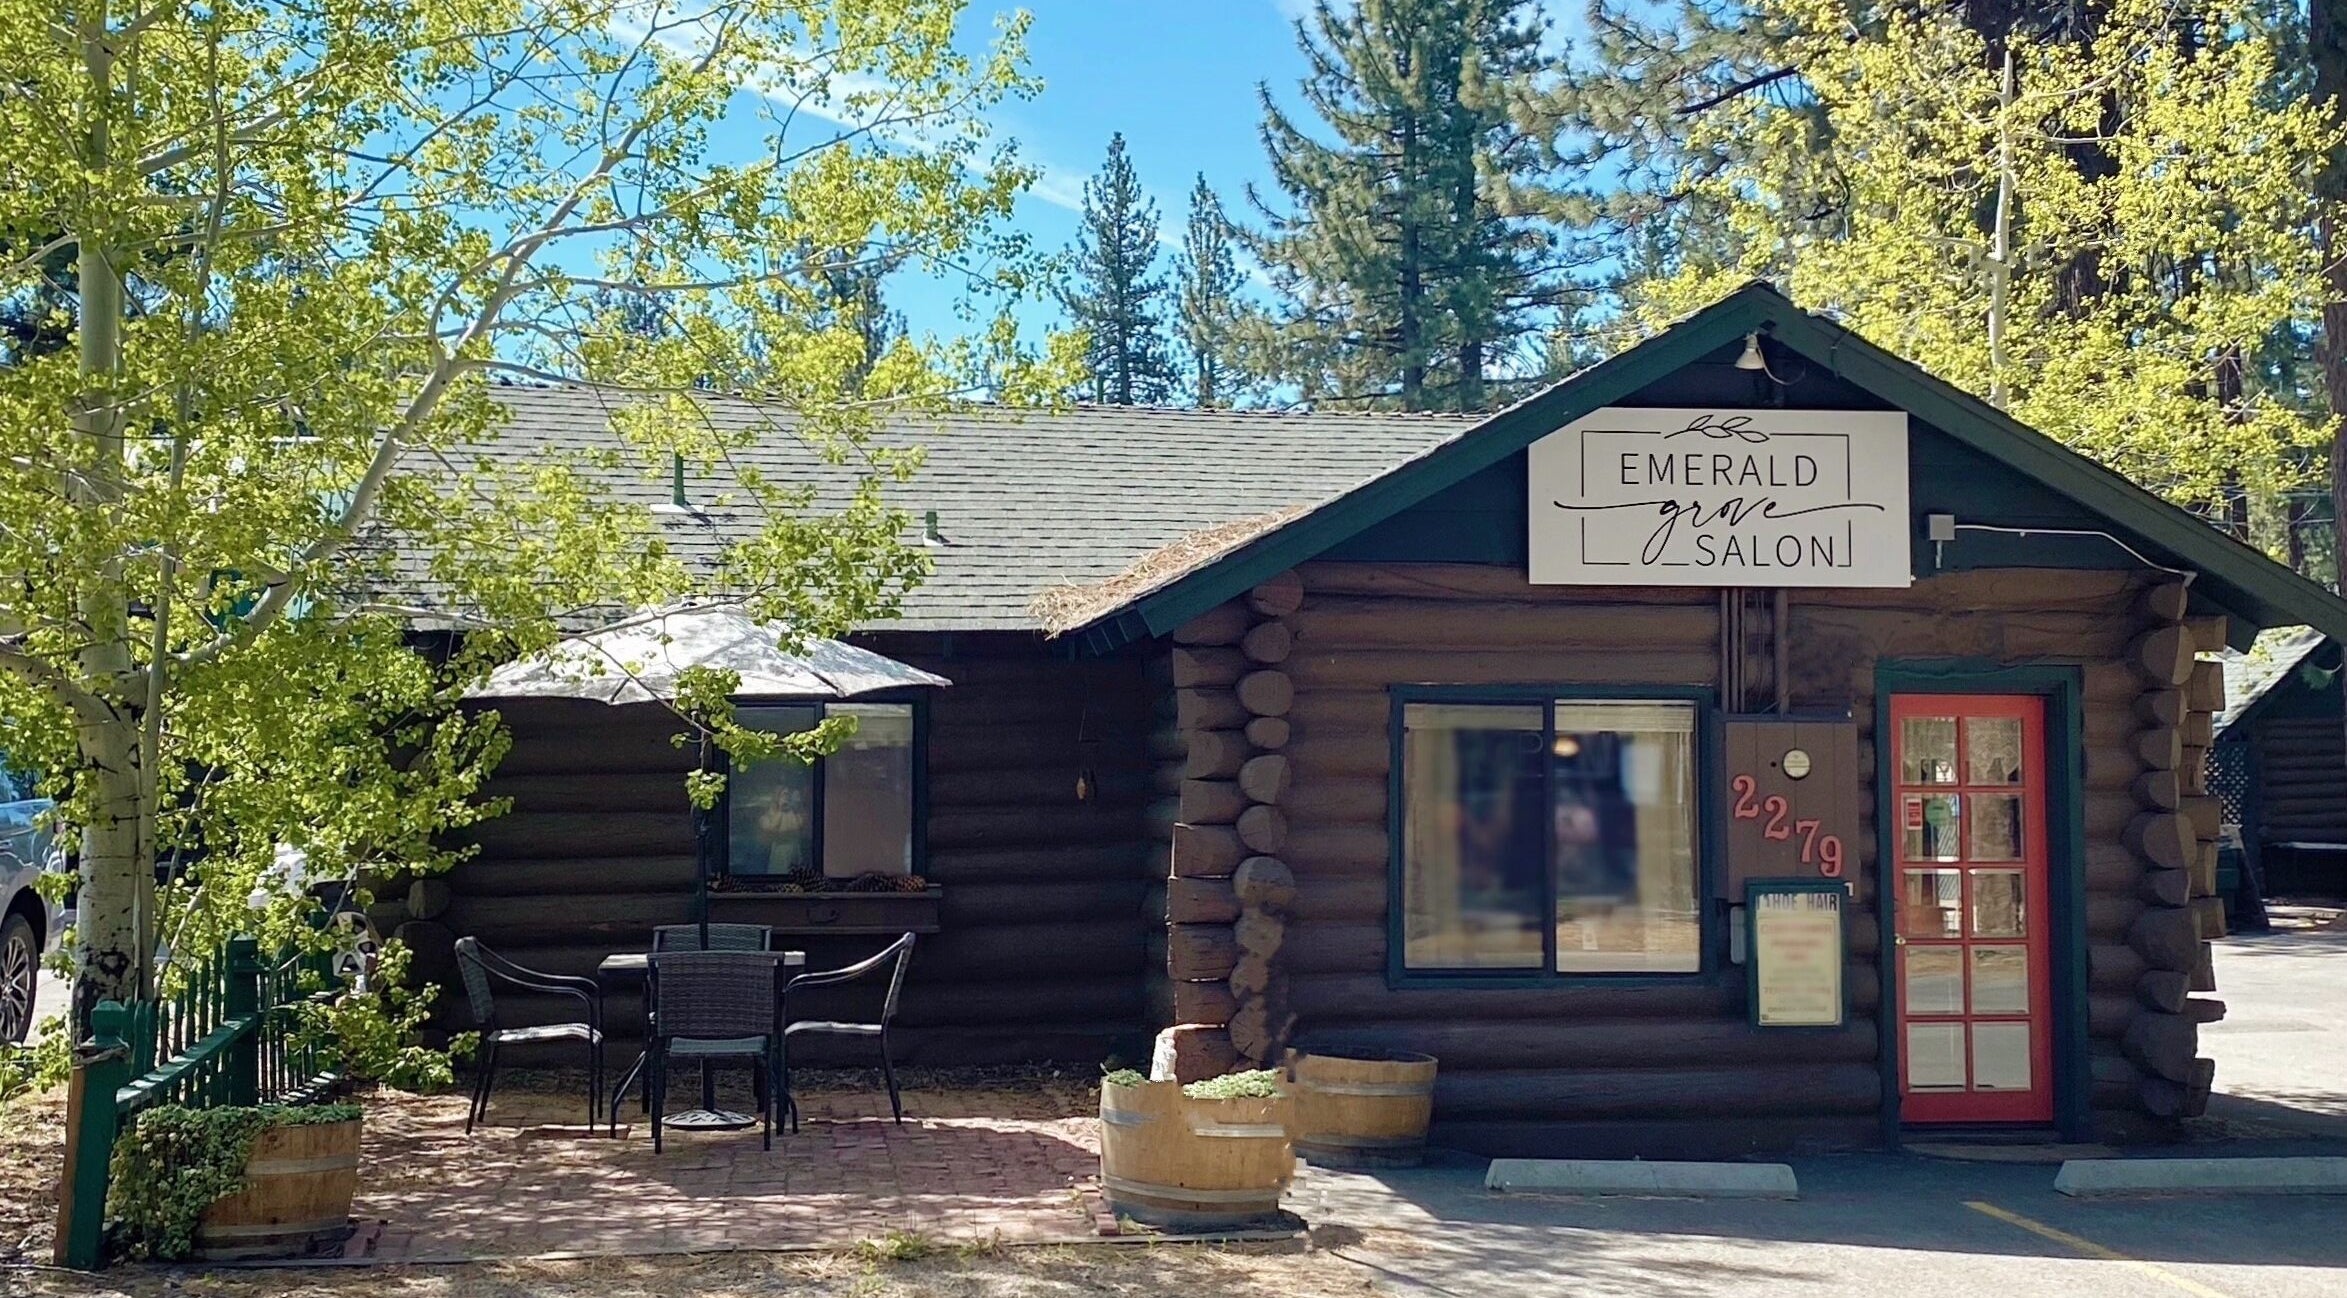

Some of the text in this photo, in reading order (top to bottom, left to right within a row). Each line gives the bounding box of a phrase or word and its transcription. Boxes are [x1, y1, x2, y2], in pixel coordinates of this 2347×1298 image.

[1620, 452, 1818, 487] EMERALD
[1694, 534, 1834, 568] SALON
[1732, 775, 1843, 878] 2279
[1757, 893, 1838, 912] HOE HAIR
